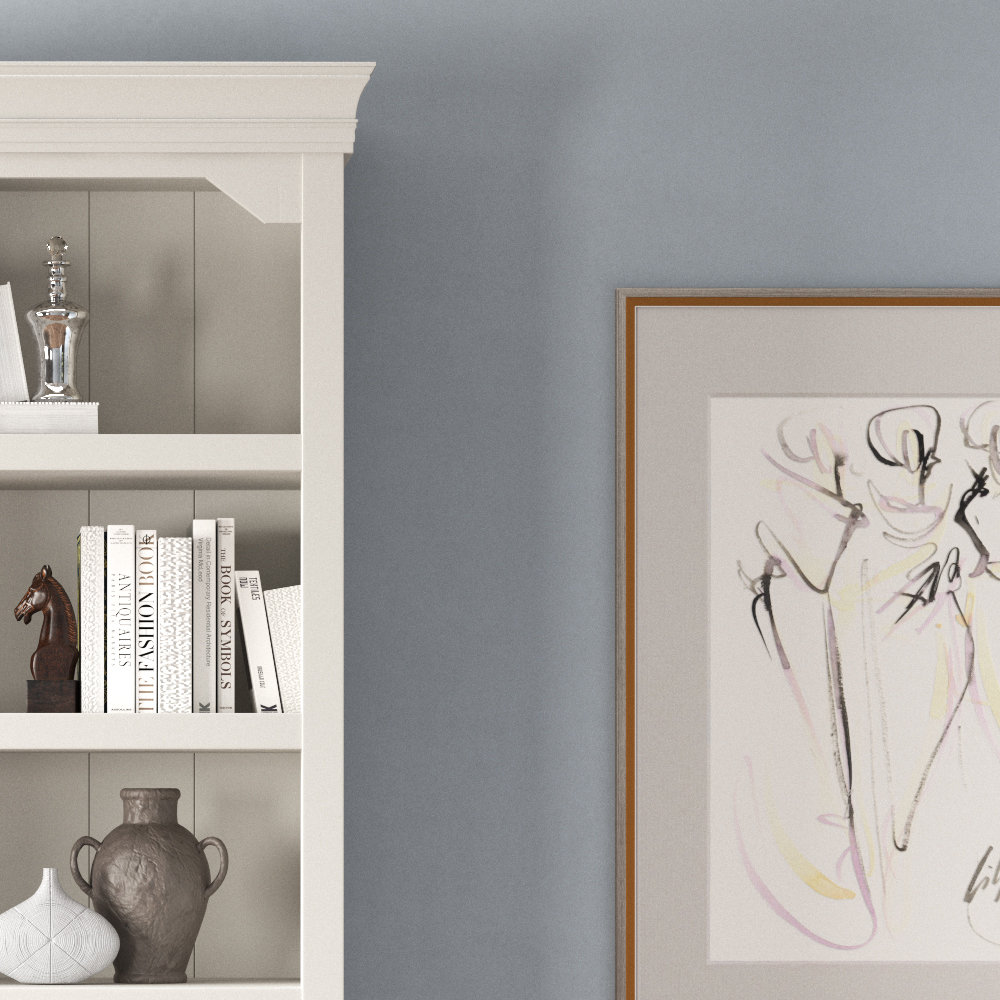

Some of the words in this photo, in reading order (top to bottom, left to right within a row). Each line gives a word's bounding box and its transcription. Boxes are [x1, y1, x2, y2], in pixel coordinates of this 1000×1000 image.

[138, 533, 155, 586] BOOK
[204, 561, 212, 600] Contemporary
[220, 565, 232, 605] BOOK
[248, 577, 261, 601] TEXTILES
[117, 573, 131, 668] ANTIQUAIRES
[138, 591, 155, 672] FASHION
[220, 607, 226, 616] OF
[220, 620, 232, 690] SYMBOLS
[138, 676, 155, 713] THE
